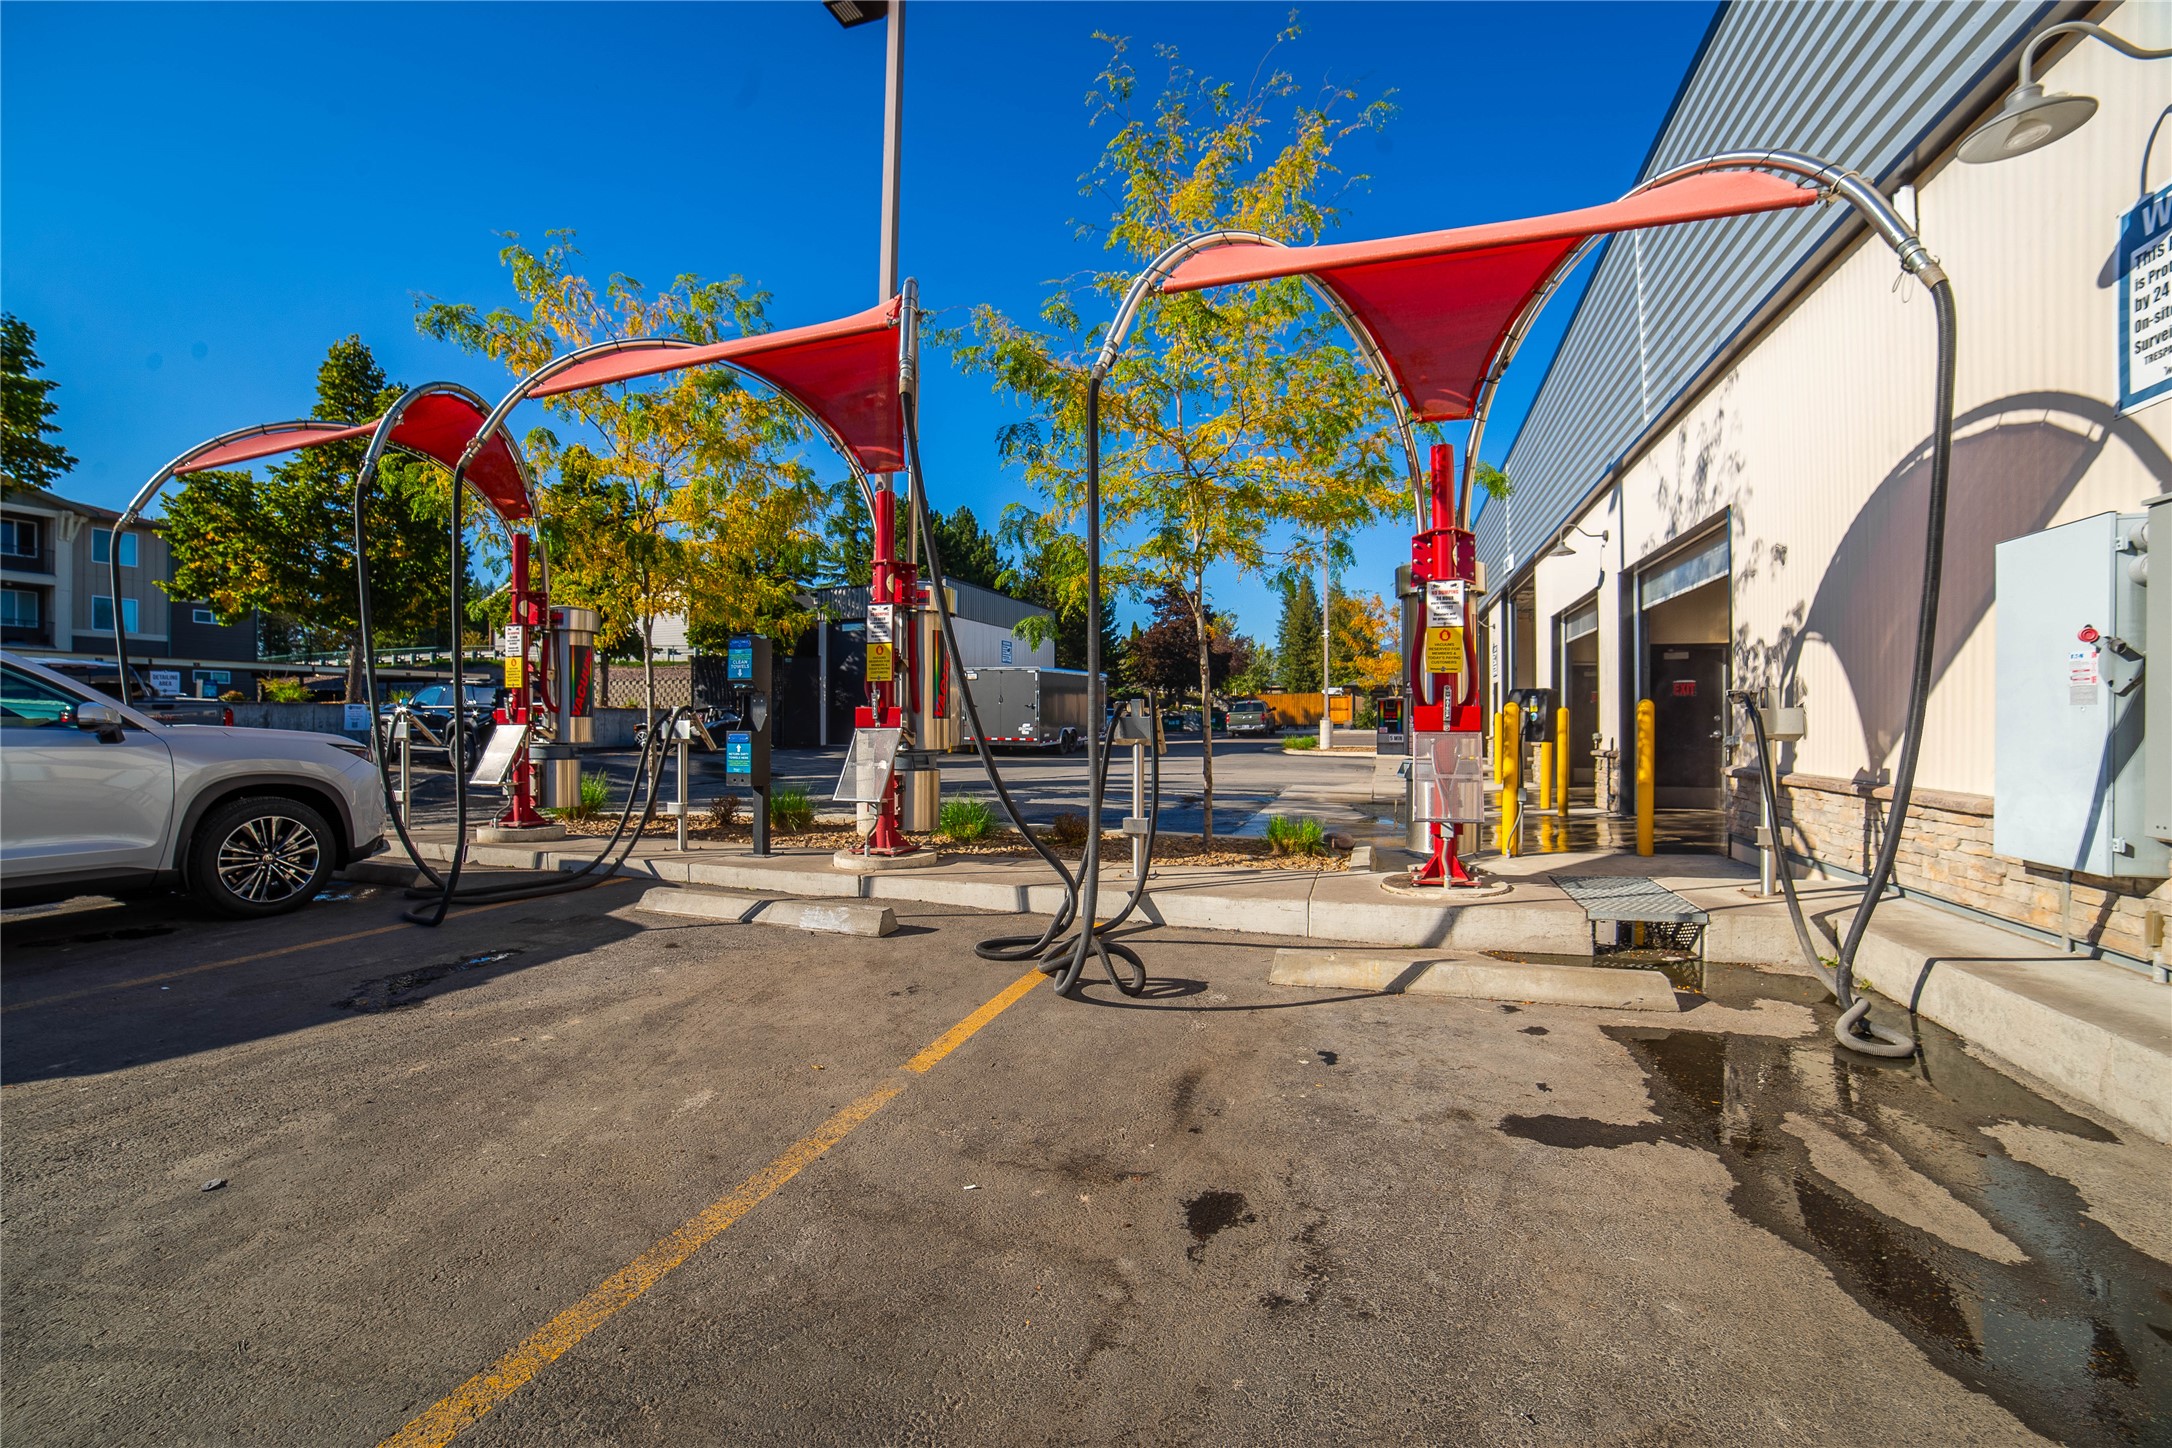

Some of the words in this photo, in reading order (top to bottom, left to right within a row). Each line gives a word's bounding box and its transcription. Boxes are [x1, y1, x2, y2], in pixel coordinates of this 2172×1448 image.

[2135, 243, 2165, 269] This
[2135, 278, 2145, 292] is
[2135, 294, 2150, 313] by
[2153, 281, 2170, 304] 24
[571, 649, 592, 716] VACUUM
[1673, 682, 1696, 697] EXIT
